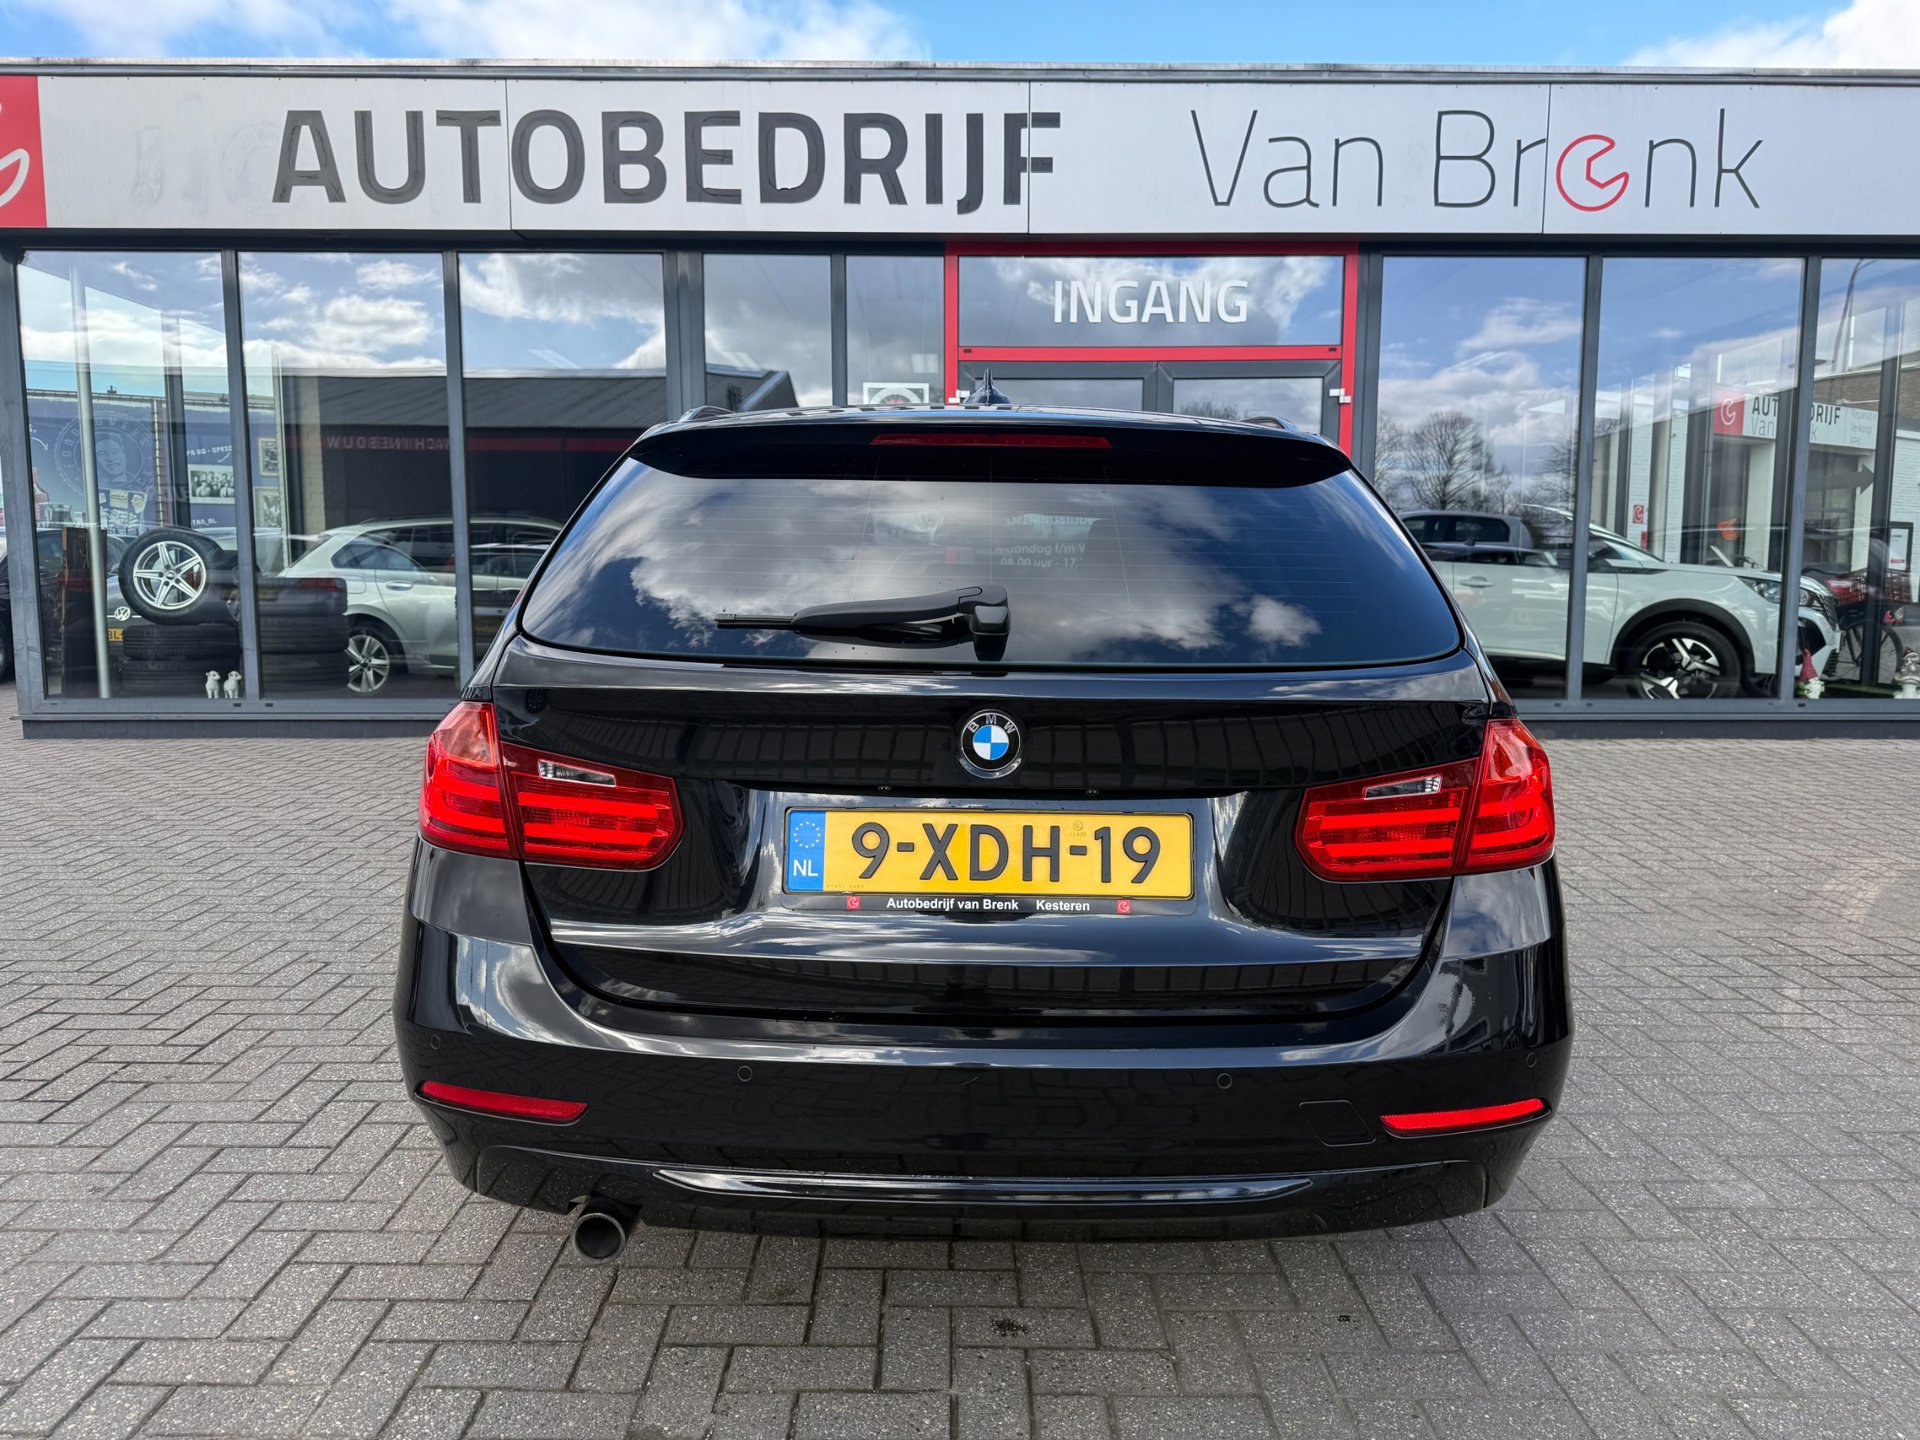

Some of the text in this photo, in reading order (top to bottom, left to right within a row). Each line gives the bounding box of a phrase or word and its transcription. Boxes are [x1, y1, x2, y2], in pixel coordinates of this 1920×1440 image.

[272, 108, 1764, 215] AUTOBEDRIJF Van Brenk
[1053, 279, 1248, 324] INGANG
[967, 713, 1017, 735] BMW
[792, 859, 819, 878] NL
[851, 821, 1161, 885] 9-XDH-19
[886, 898, 1091, 912] Autobedrijf van Brenk Kesteren
